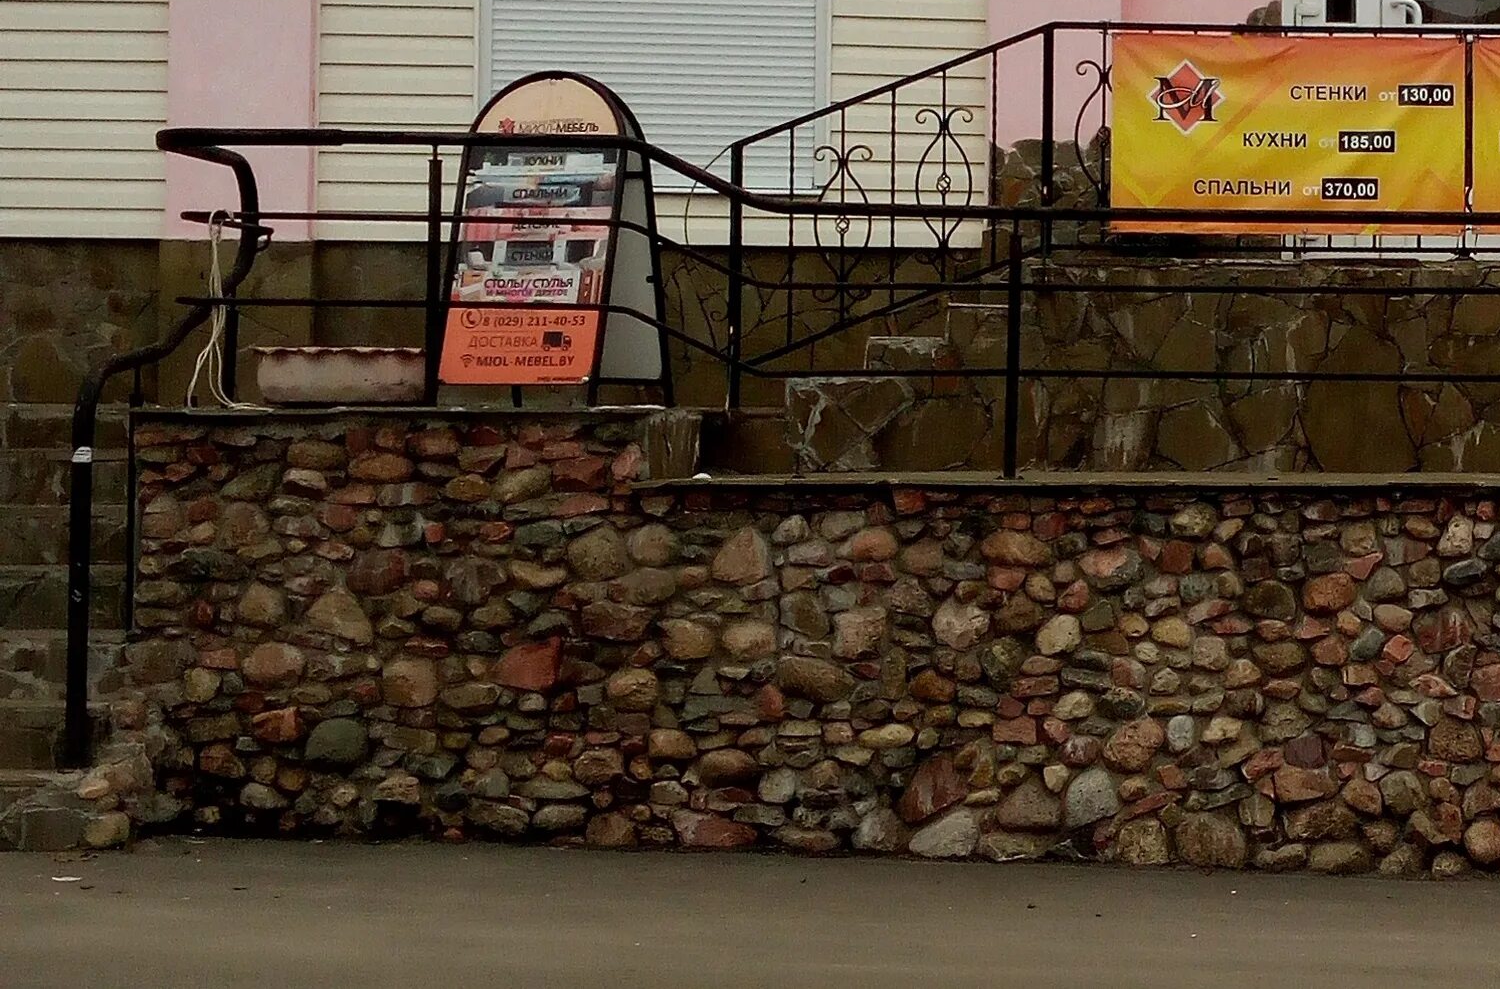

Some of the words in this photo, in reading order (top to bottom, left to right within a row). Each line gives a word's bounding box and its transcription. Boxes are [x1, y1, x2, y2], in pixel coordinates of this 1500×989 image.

[1290, 85, 1368, 102] СТЕНКИ
[1378, 91, 1397, 102] от
[1400, 87, 1452, 104] 130,00
[1242, 132, 1307, 149] КУХНИ
[1340, 134, 1392, 151] 185,00
[1193, 179, 1291, 196] СПАЛЬНИ
[1324, 182, 1376, 198] 370,00
[484, 278, 524, 288] СТОЛЫ
[532, 278, 574, 288] СТУЛЬЯ
[482, 316, 490, 326] 8
[493, 316, 523, 328] (029)
[527, 315, 586, 327] 211-40-53
[468, 335, 538, 349] ДОСТАВКА
